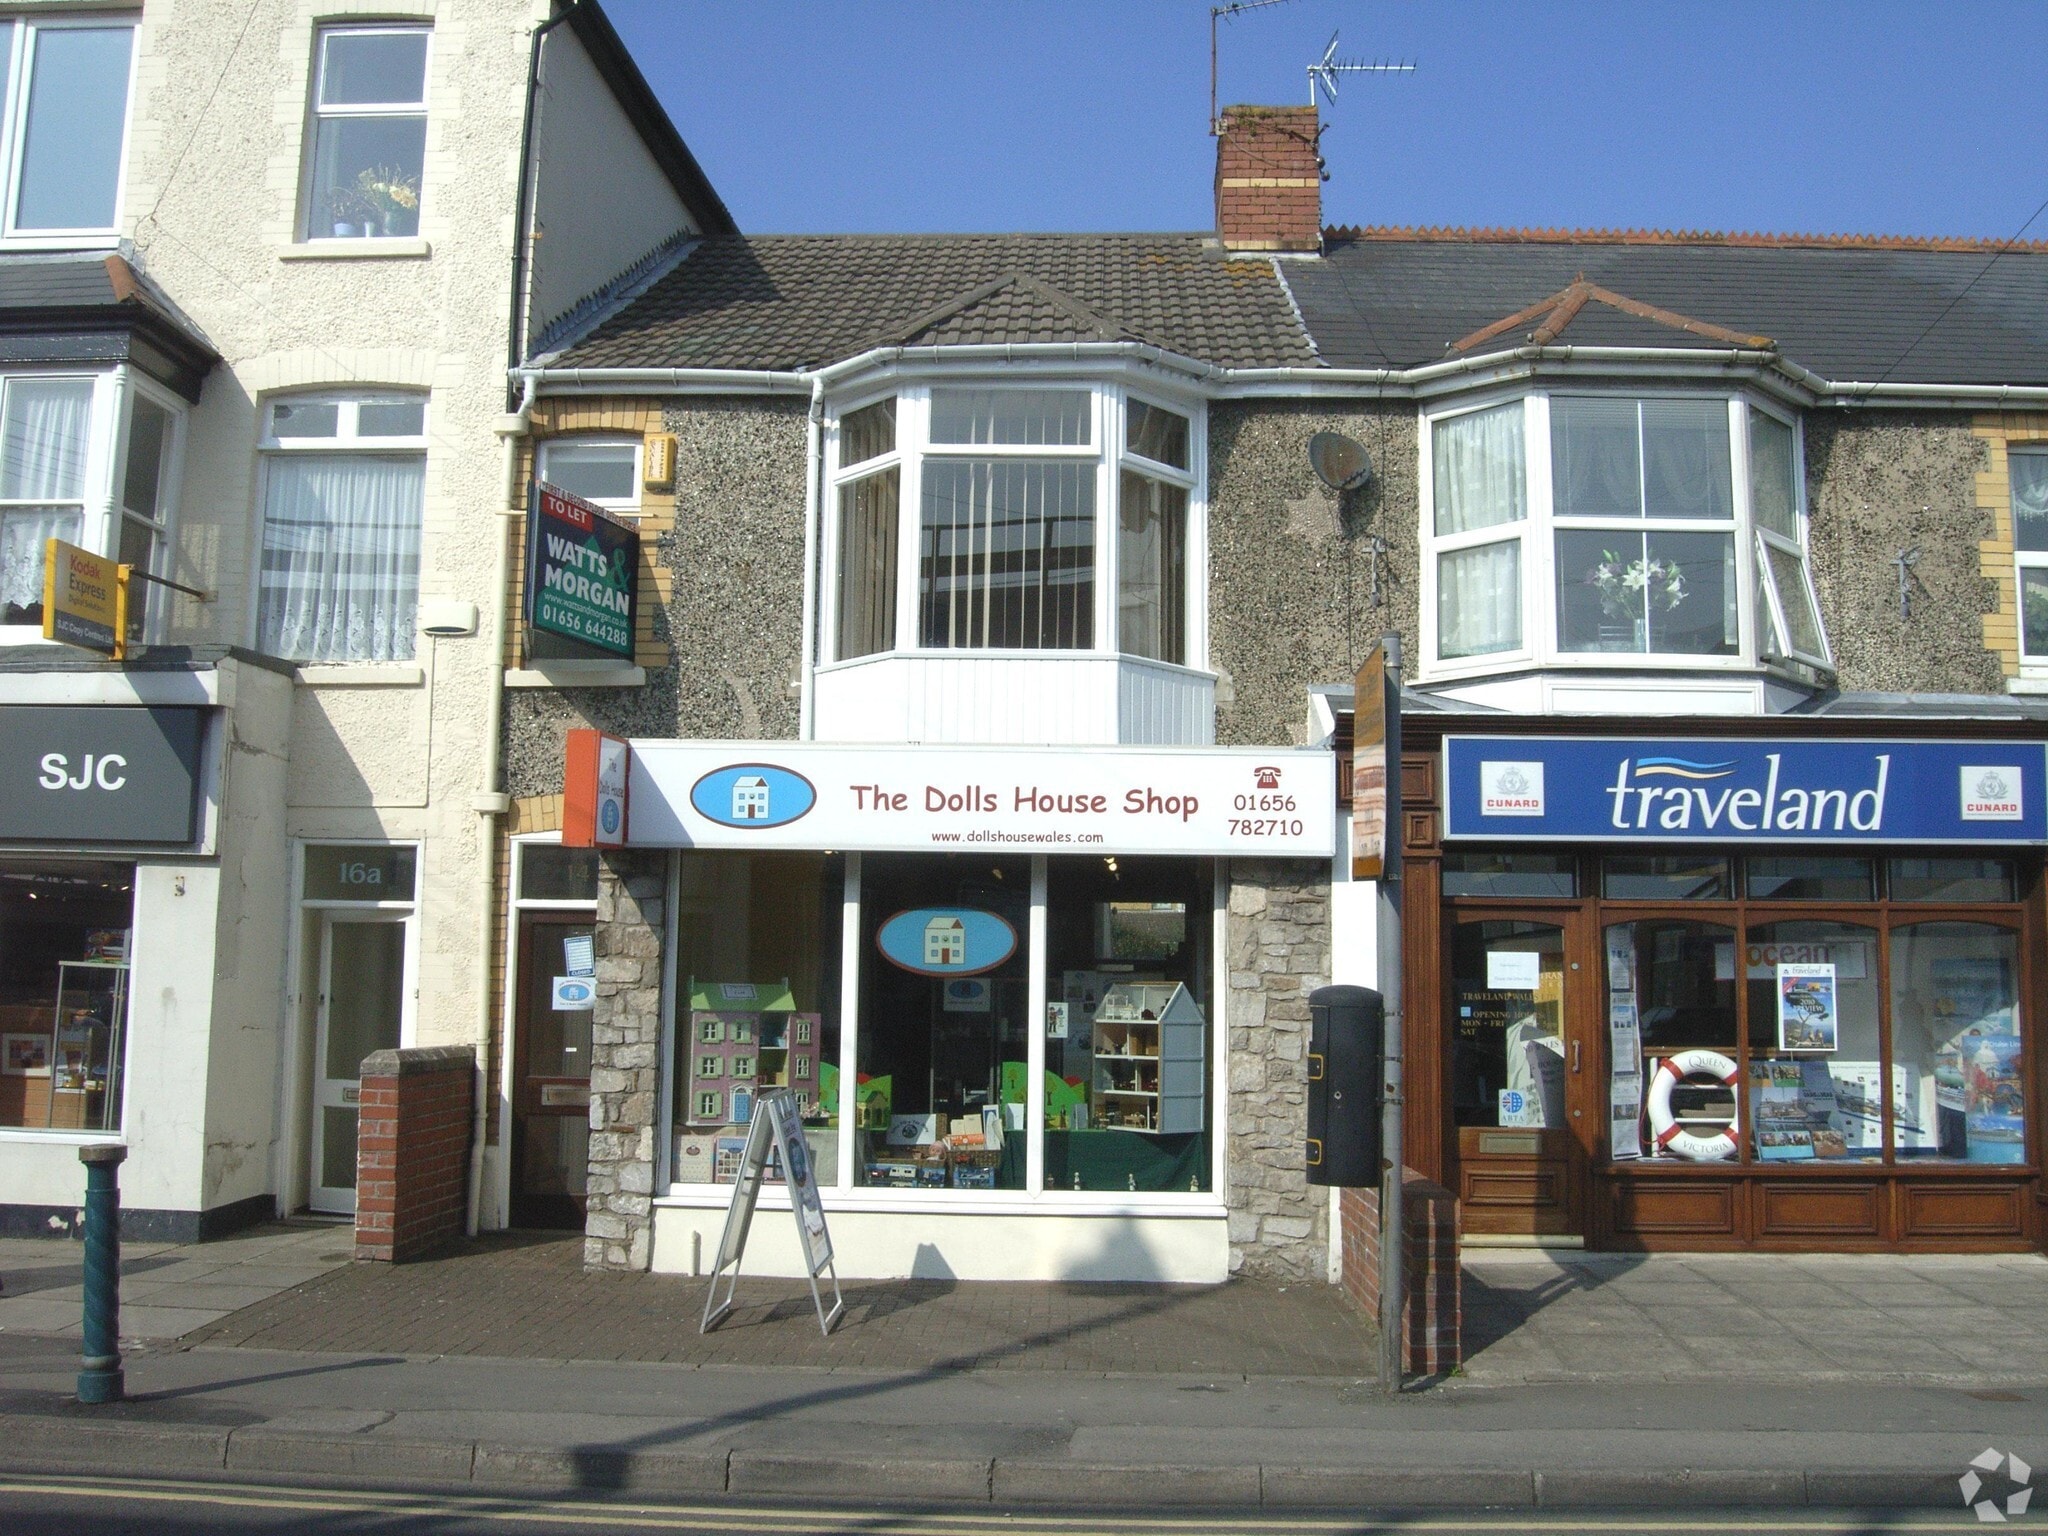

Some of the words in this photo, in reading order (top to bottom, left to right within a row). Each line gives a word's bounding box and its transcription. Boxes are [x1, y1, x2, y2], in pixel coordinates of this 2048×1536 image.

[548, 496, 565, 514] TO
[567, 505, 588, 524] LET
[546, 533, 608, 577] WATTS
[70, 554, 101, 579] Kodak
[69, 572, 107, 601] Express
[545, 563, 630, 617] MORGAN
[69, 622, 84, 637] Copy
[543, 604, 581, 631] 01656
[585, 619, 627, 647] 644288
[39, 753, 127, 791] SJC
[1606, 754, 1890, 831] traveland
[849, 784, 908, 811] The
[925, 785, 998, 812] Dolls
[1014, 786, 1108, 813] House
[1123, 787, 1199, 822] Shop
[1234, 794, 1296, 811] 01656
[1487, 799, 1539, 808] CUNARD
[1967, 804, 2018, 812] CUNARD
[931, 830, 1104, 843] www.dollshousewales.com
[1228, 819, 1303, 836] 782710
[340, 863, 383, 884] 16a
[1462, 992, 1511, 1000] TRAVELAND
[1460, 1028, 1477, 1036] SAT
[1689, 1055, 1727, 1069] QUEEN
[1683, 1140, 1729, 1153] VICTORIA
